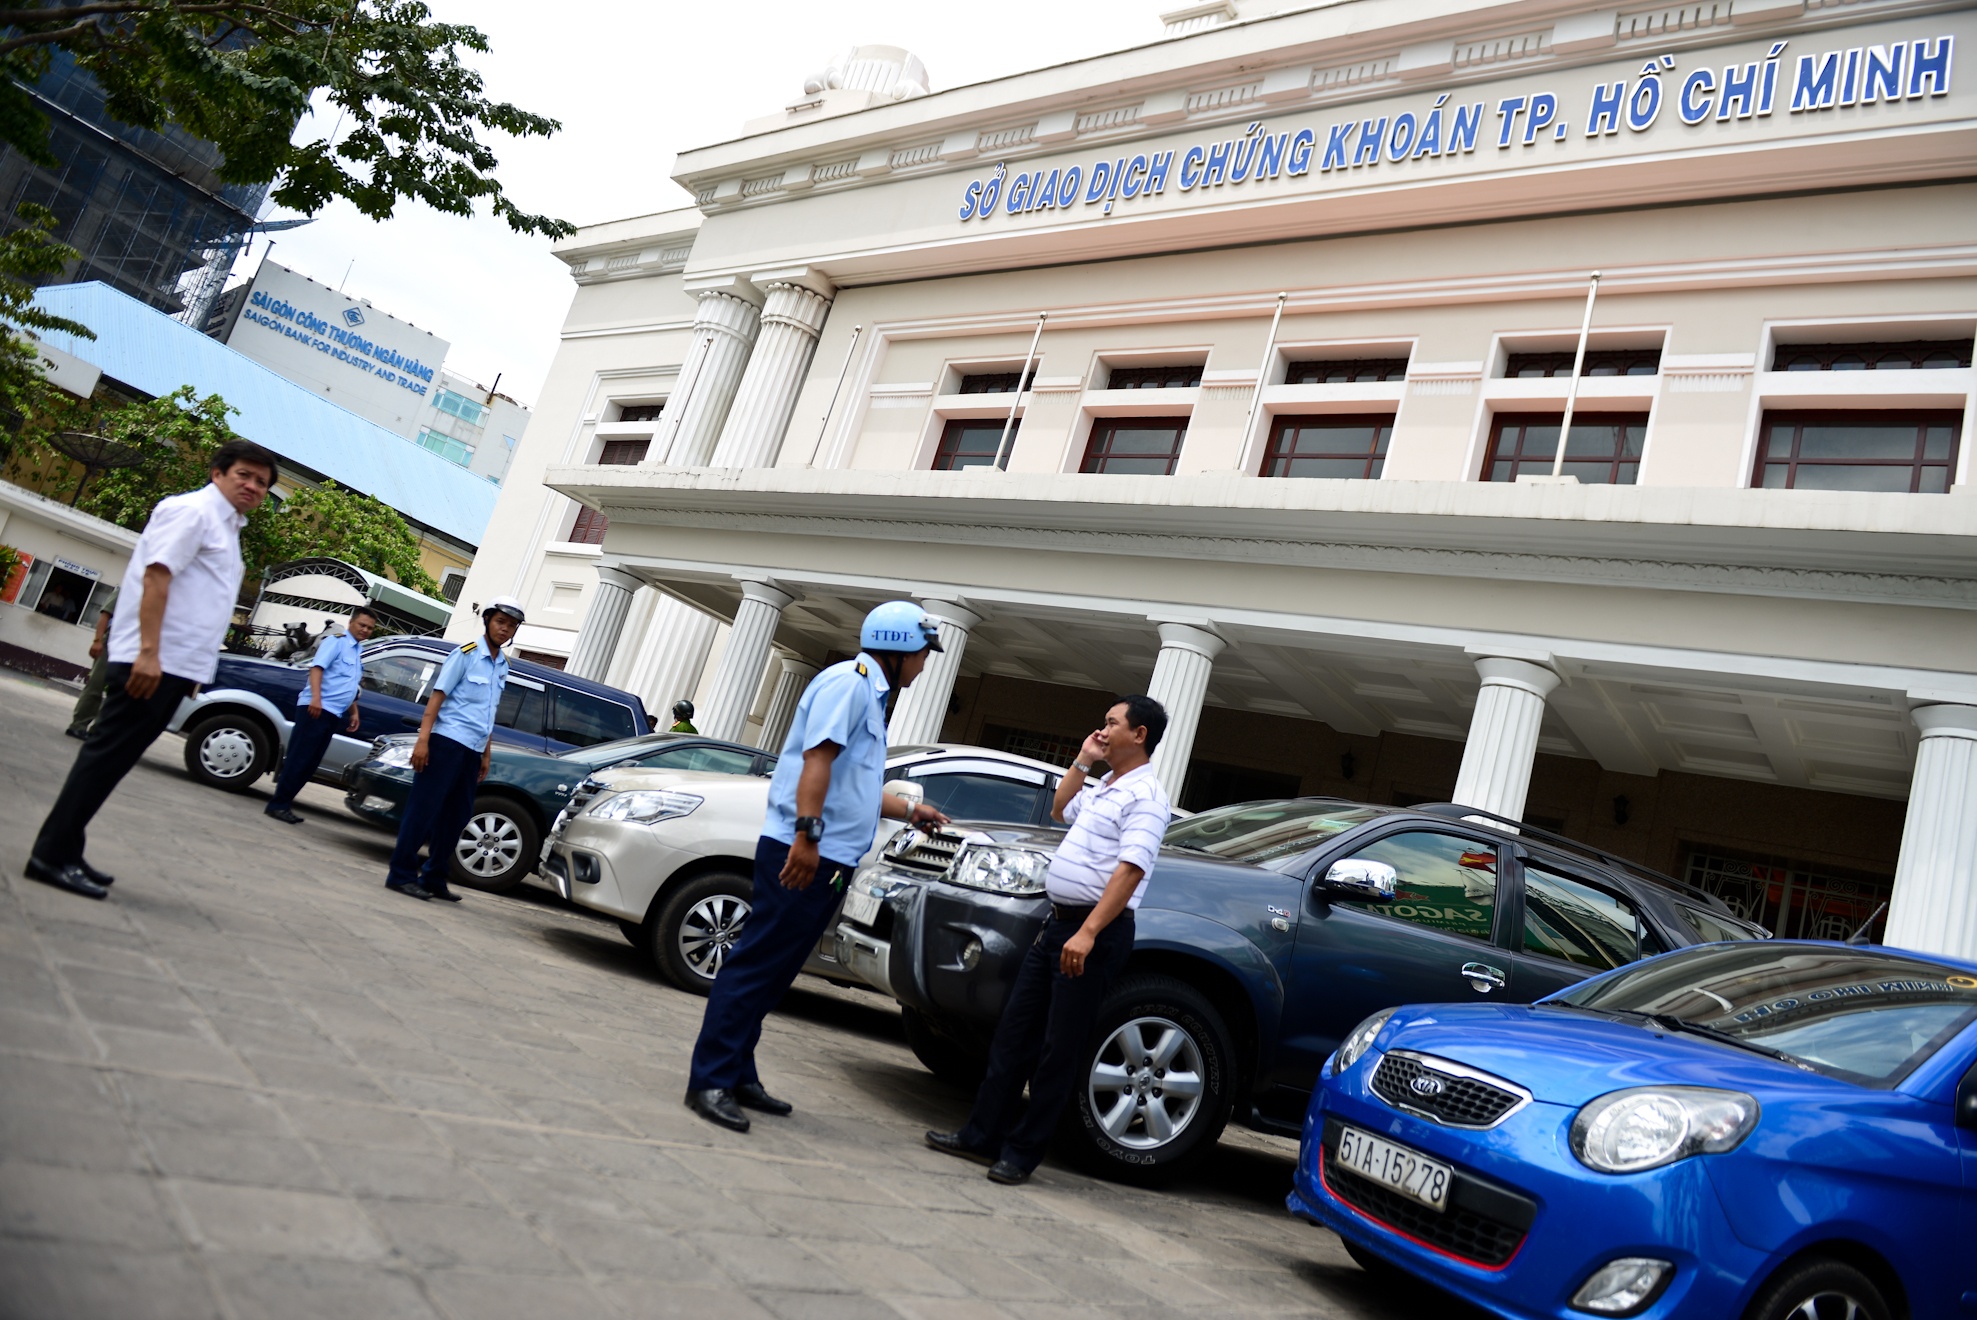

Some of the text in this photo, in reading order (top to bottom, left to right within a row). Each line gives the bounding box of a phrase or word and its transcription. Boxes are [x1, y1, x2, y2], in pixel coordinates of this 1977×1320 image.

[959, 35, 1955, 221] SỞ GIAO DỊCH CHỨNG KHOÁN TP. HỒ CHÍ MINH
[243, 309, 285, 334] SAIGON
[284, 327, 312, 346] BANK
[311, 339, 331, 355] FOR
[330, 348, 376, 375] INDUSTRY
[374, 368, 396, 382] AND
[396, 377, 428, 397] TRADE
[250, 291, 434, 383] SÀI GÒN CÔNG THƯƠNG NGÂN HÀNG
[873, 630, 910, 642] TTĐT
[1414, 1077, 1436, 1094] KIA
[1096, 1137, 1156, 1165] TOYO
